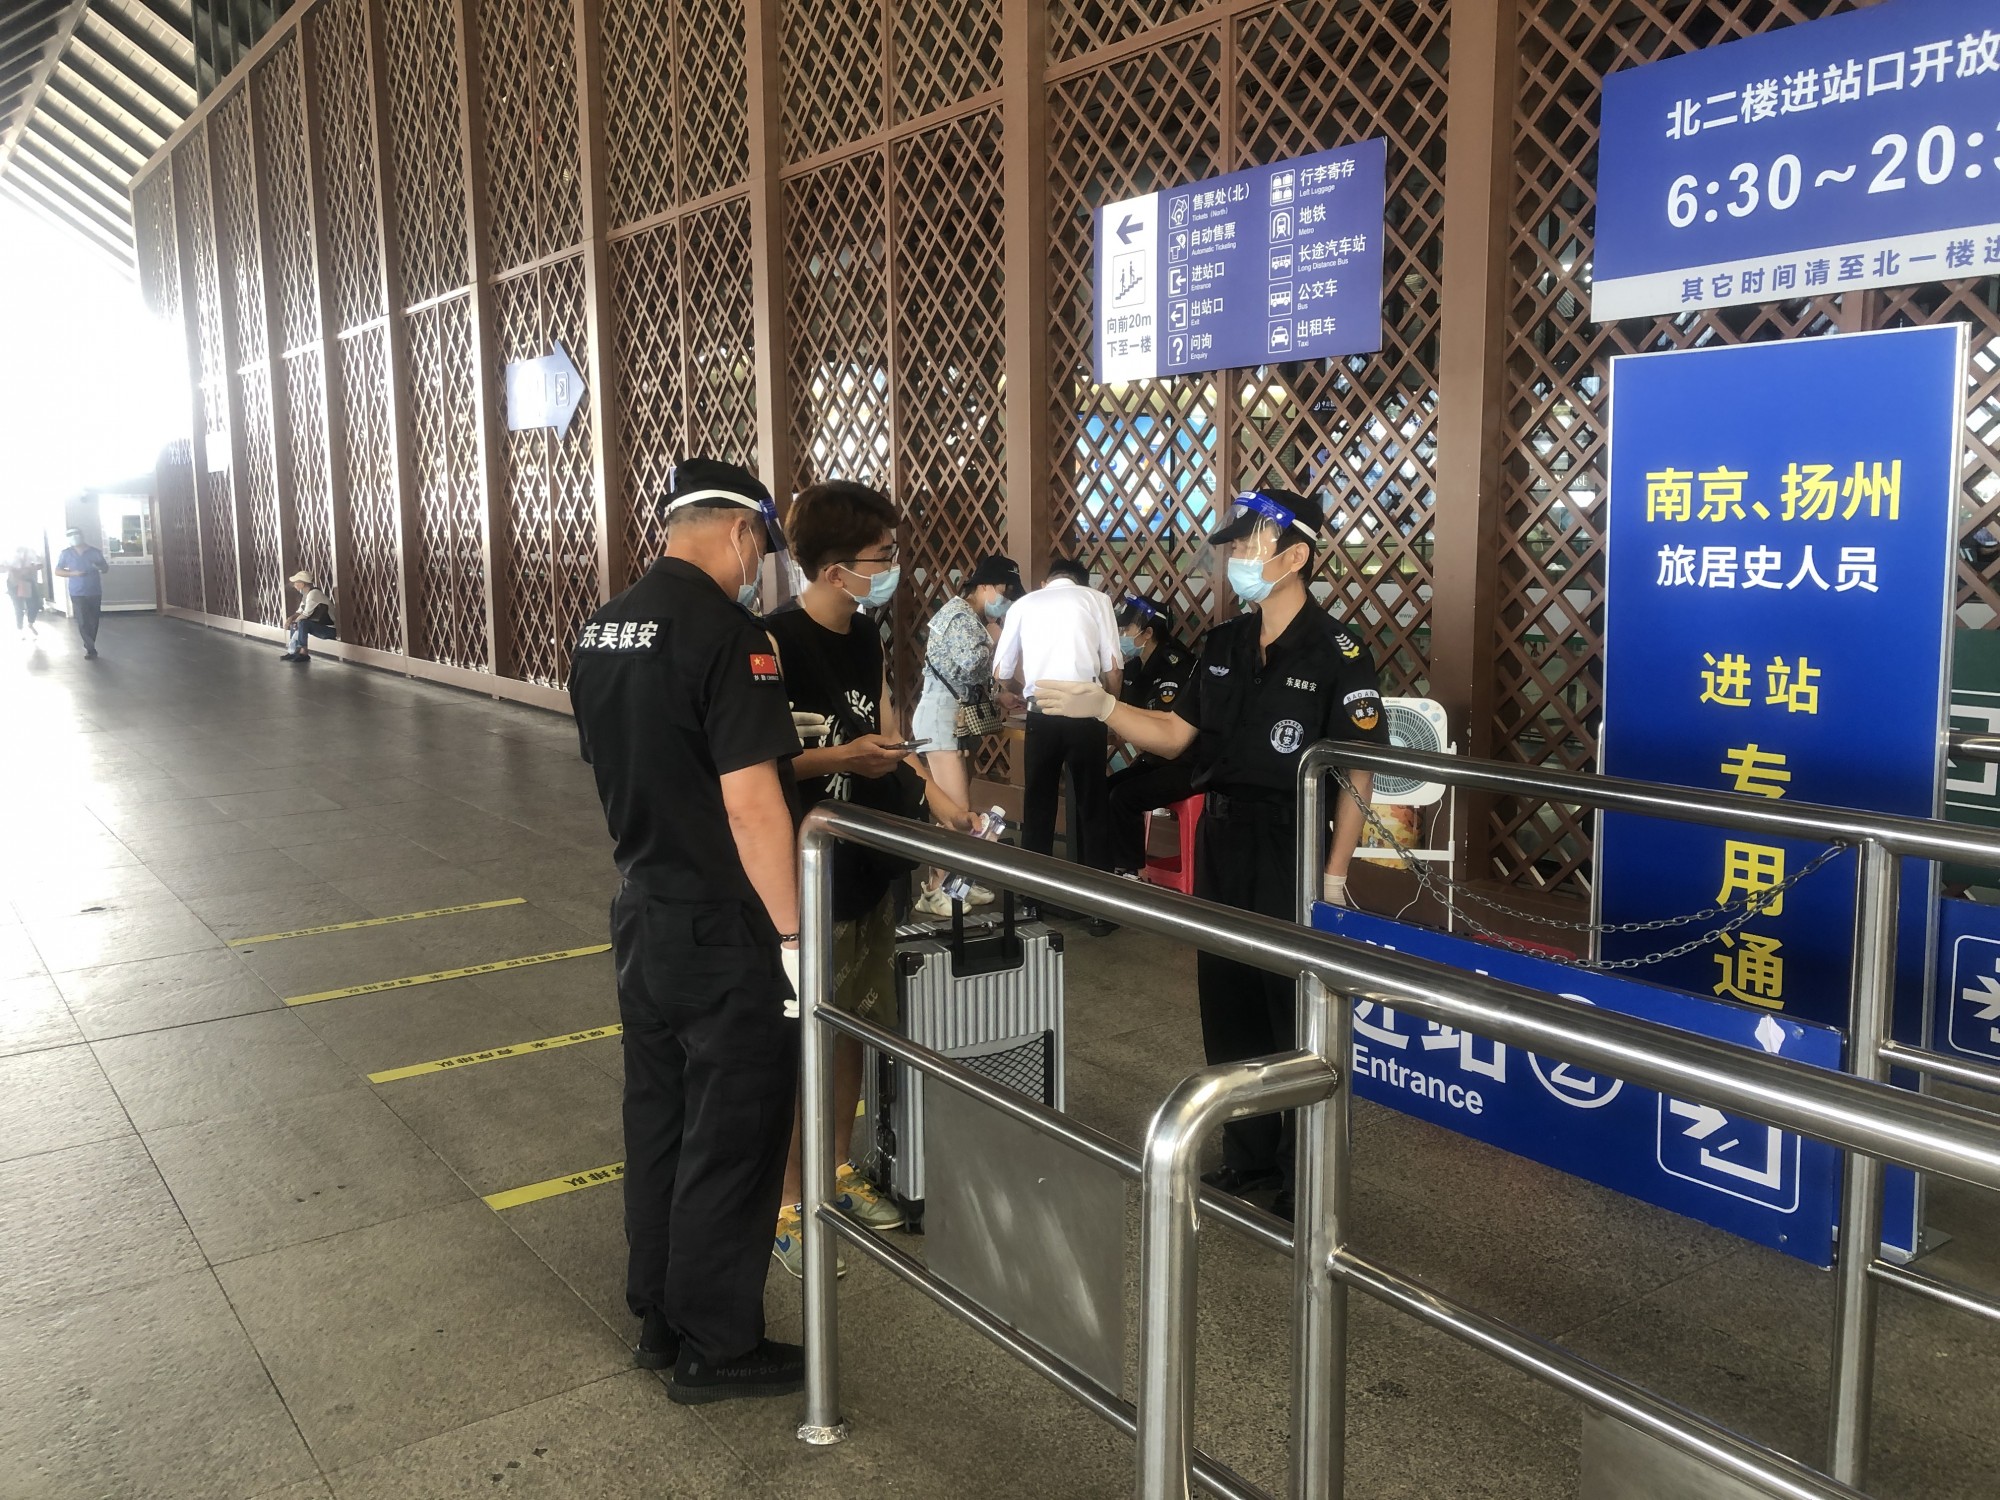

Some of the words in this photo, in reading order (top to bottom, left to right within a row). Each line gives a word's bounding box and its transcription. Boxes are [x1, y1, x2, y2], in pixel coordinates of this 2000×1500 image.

[1666, 29, 2000, 140] 北二楼进站口开放
[1300, 159, 1355, 187] 行李寄存
[1667, 121, 2000, 229] 6:30~20:
[1192, 183, 1250, 211] 售票处(北)
[1300, 187, 1310, 197] Left
[1311, 184, 1336, 196] Luggage
[1192, 210, 1209, 221] Tickets
[1210, 207, 1228, 219] (North)
[1299, 203, 1327, 225] 地铁
[1191, 222, 1236, 247] 自动售票
[1299, 227, 1315, 236] Metro
[1191, 244, 1214, 256] Automatic
[1215, 241, 1236, 253] Ticketing
[1298, 234, 1367, 262] 长途汽车站
[1191, 262, 1225, 283] 进站口
[1298, 263, 1311, 273] Long
[1312, 259, 1336, 270] Distance
[1338, 257, 1349, 267] Bus
[1191, 282, 1212, 292] Entrance
[1298, 279, 1338, 300] 公交车
[1191, 298, 1224, 317] 出站口
[1297, 303, 1308, 311] Bus
[1106, 313, 1152, 335] 向前20m
[1191, 318, 1200, 326] Exit
[1297, 317, 1336, 339] 出租车
[1106, 335, 1152, 359] 下至一楼
[1191, 334, 1212, 351] 问询
[1190, 352, 1208, 361] Enquiry
[1645, 459, 1902, 523] 南京、扬州
[1656, 544, 1879, 593] 旅居史人员
[579, 620, 659, 650] 东吴保安
[1285, 676, 1318, 692] 东吴保安
[1699, 652, 1822, 714] 进站
[1355, 706, 1375, 719] 保安
[1351, 1042, 1484, 1115] Entrance
